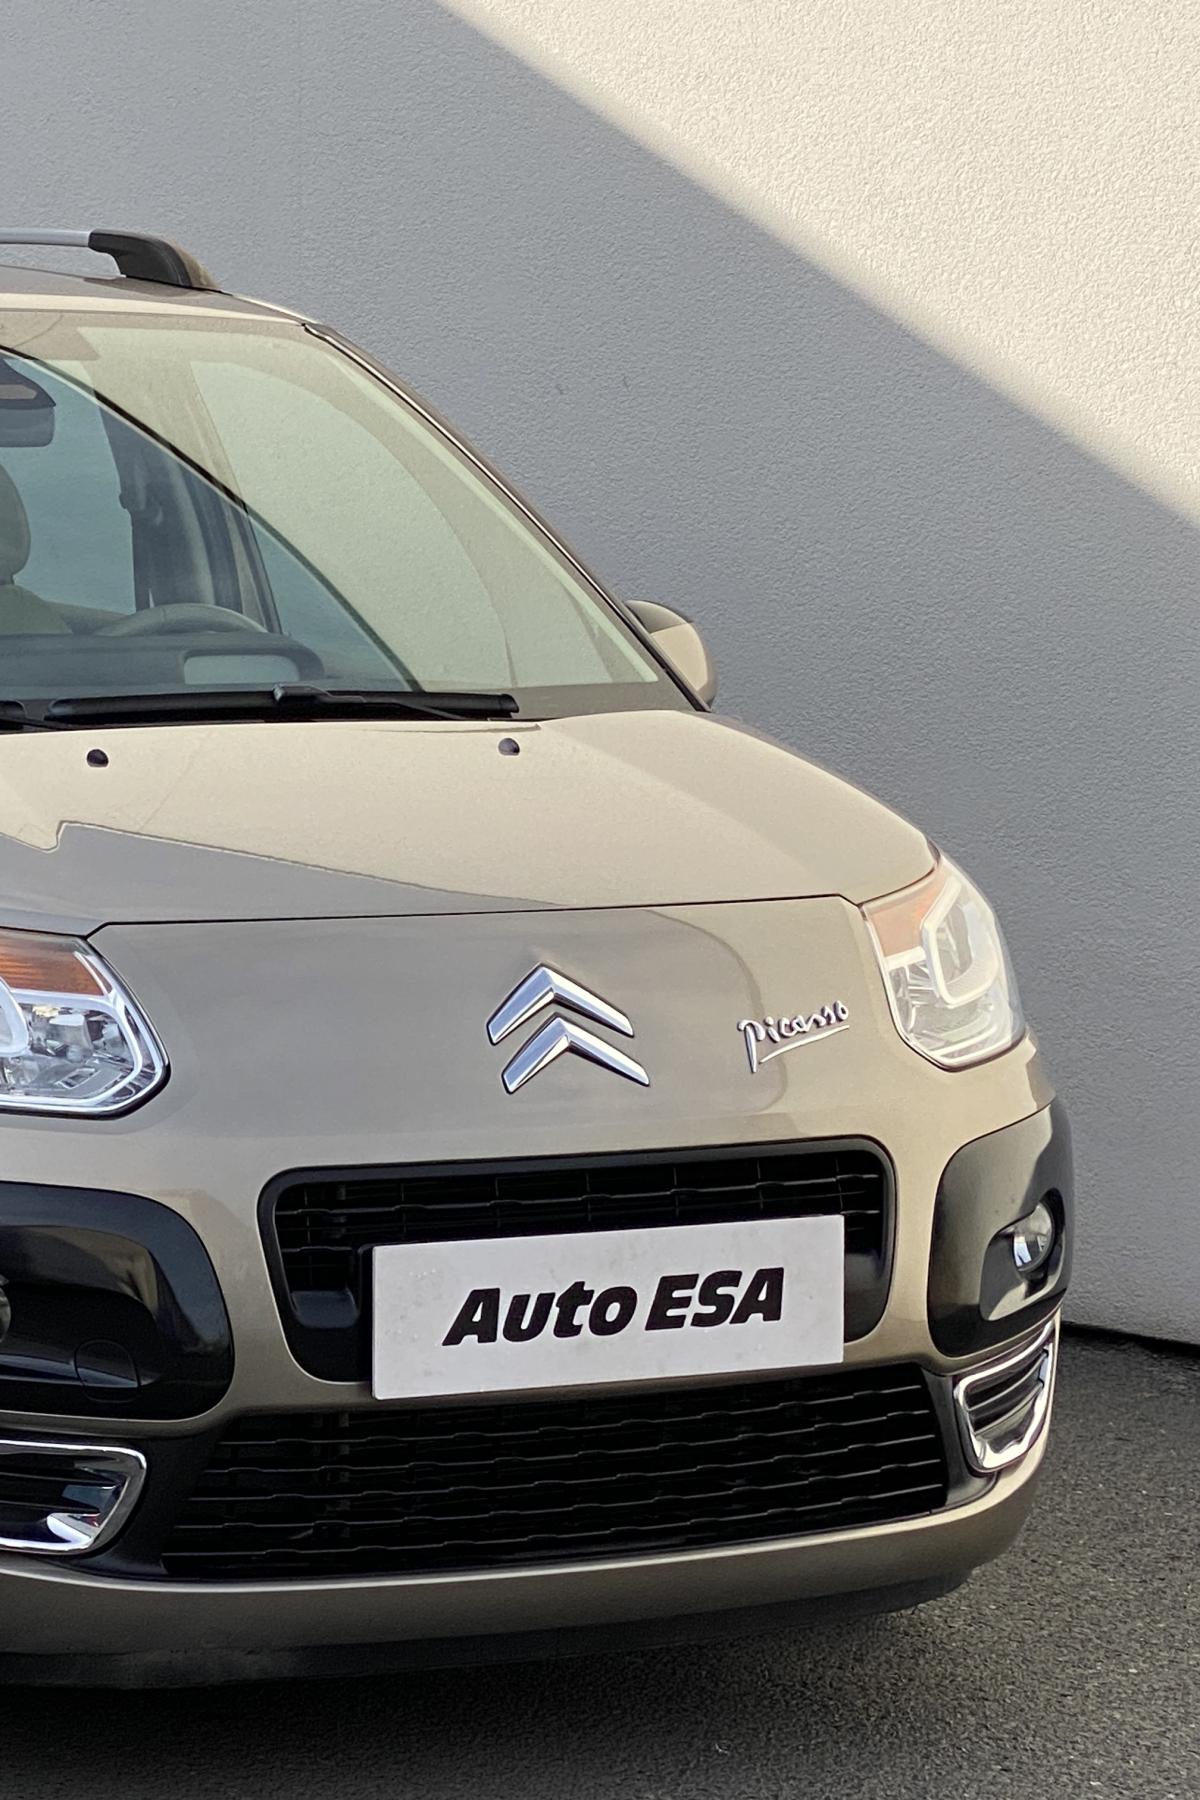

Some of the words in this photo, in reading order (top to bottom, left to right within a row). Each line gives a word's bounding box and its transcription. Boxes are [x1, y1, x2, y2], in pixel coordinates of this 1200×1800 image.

[737, 1000, 849, 1073] Picasso
[442, 1280, 638, 1347] Auto
[645, 1266, 785, 1332] ESA
